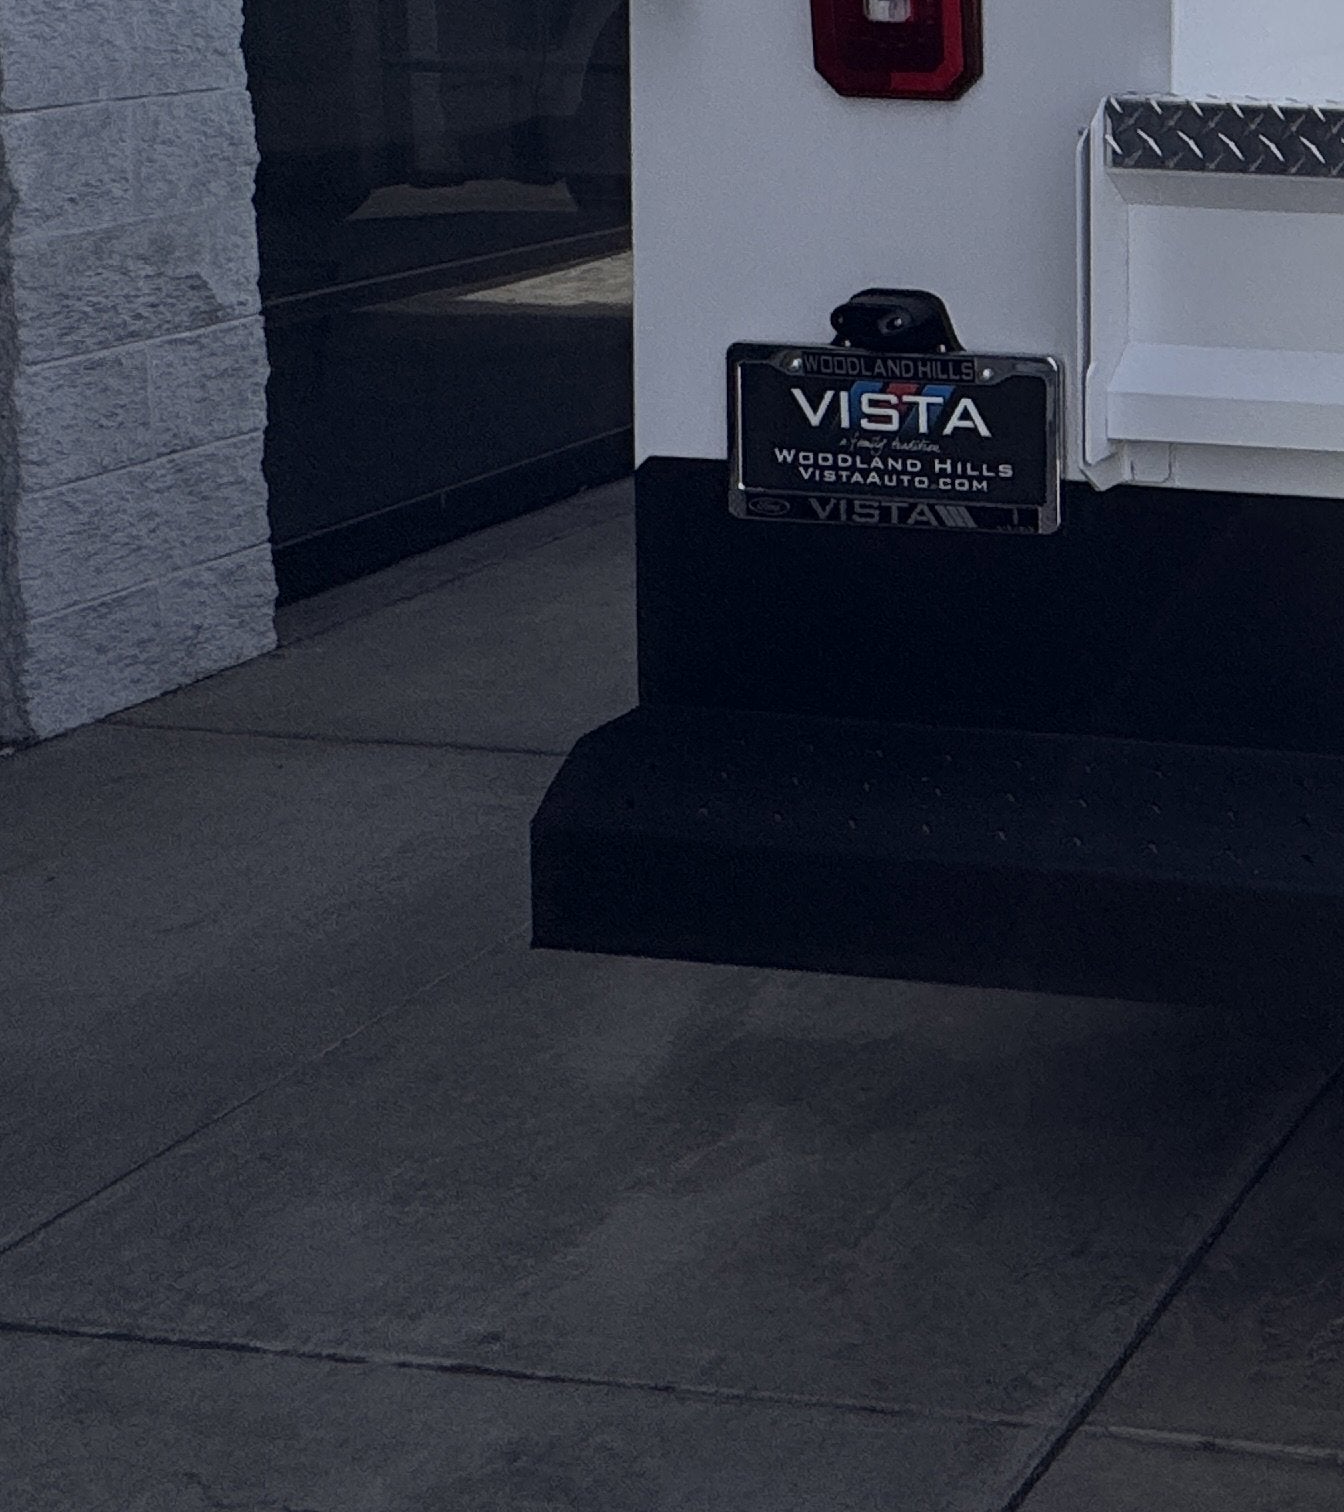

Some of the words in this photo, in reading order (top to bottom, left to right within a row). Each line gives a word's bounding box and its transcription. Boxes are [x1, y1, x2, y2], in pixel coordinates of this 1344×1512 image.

[804, 355, 914, 378] WOODLAND
[917, 361, 974, 381] HILLS
[790, 387, 993, 438] VISTA
[774, 447, 922, 472] WOODLAND
[934, 458, 1013, 478] HILLS
[808, 497, 940, 527] VISTA
